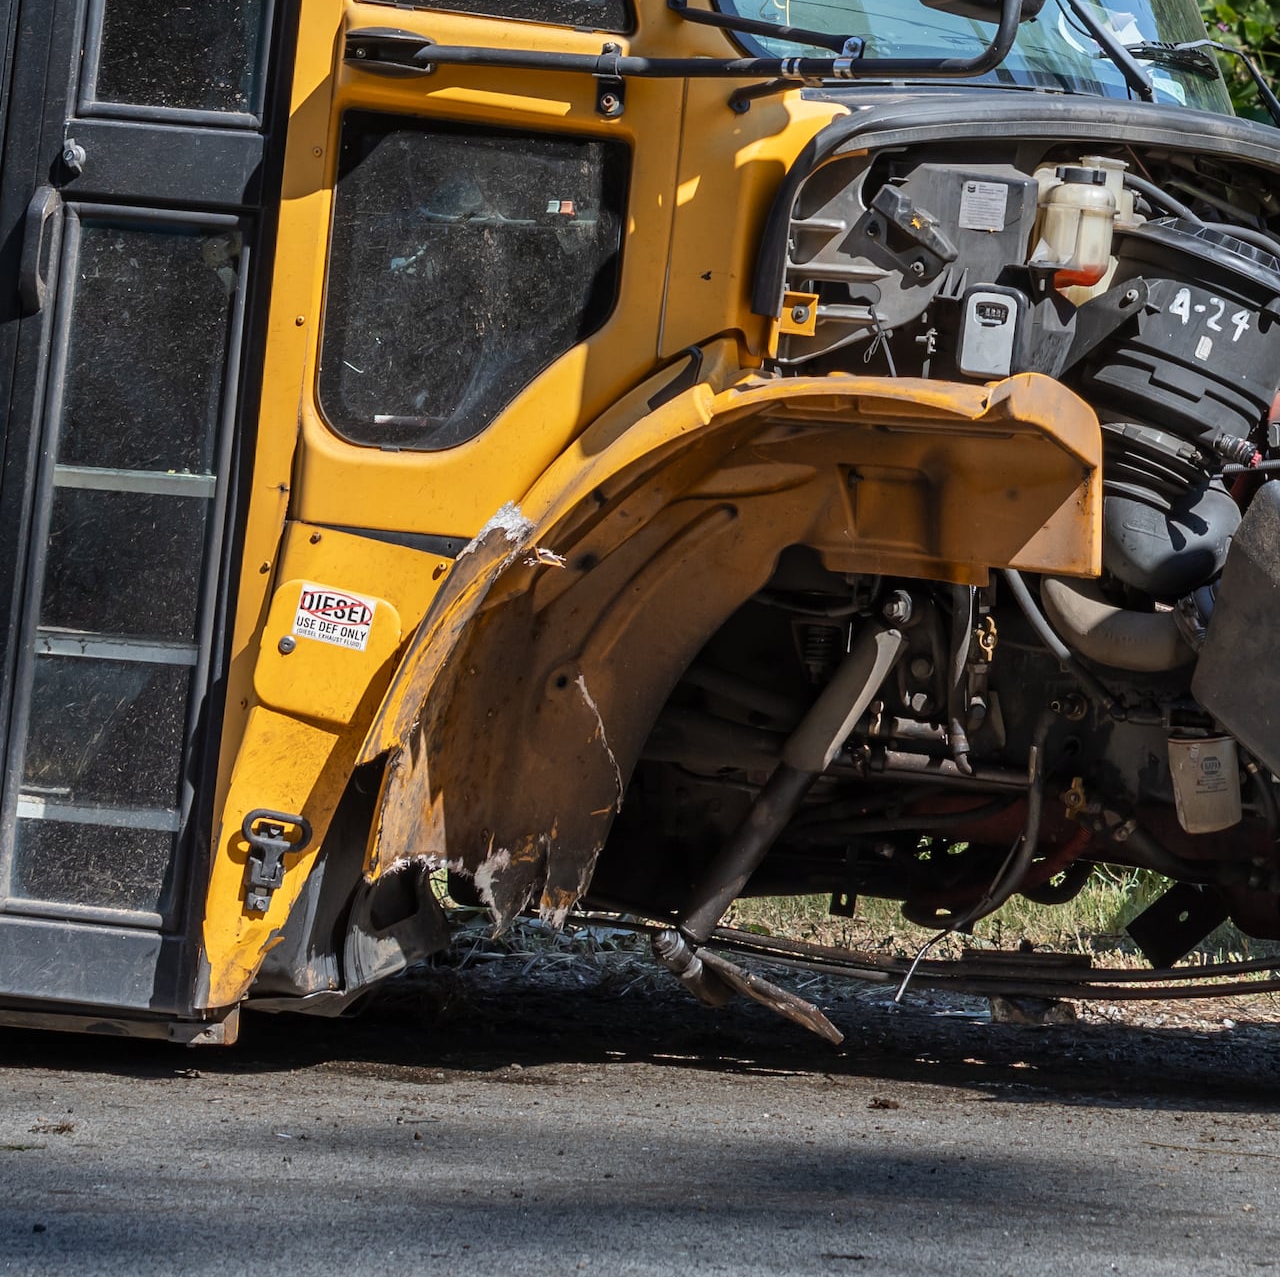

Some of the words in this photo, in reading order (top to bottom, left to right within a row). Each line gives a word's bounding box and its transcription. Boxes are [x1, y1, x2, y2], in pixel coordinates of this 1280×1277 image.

[300, 591, 370, 626] DIESEL
[297, 616, 316, 629] USE
[318, 621, 338, 634] DEF
[340, 627, 366, 642] ONLY
[318, 633, 343, 643] EXHAUST
